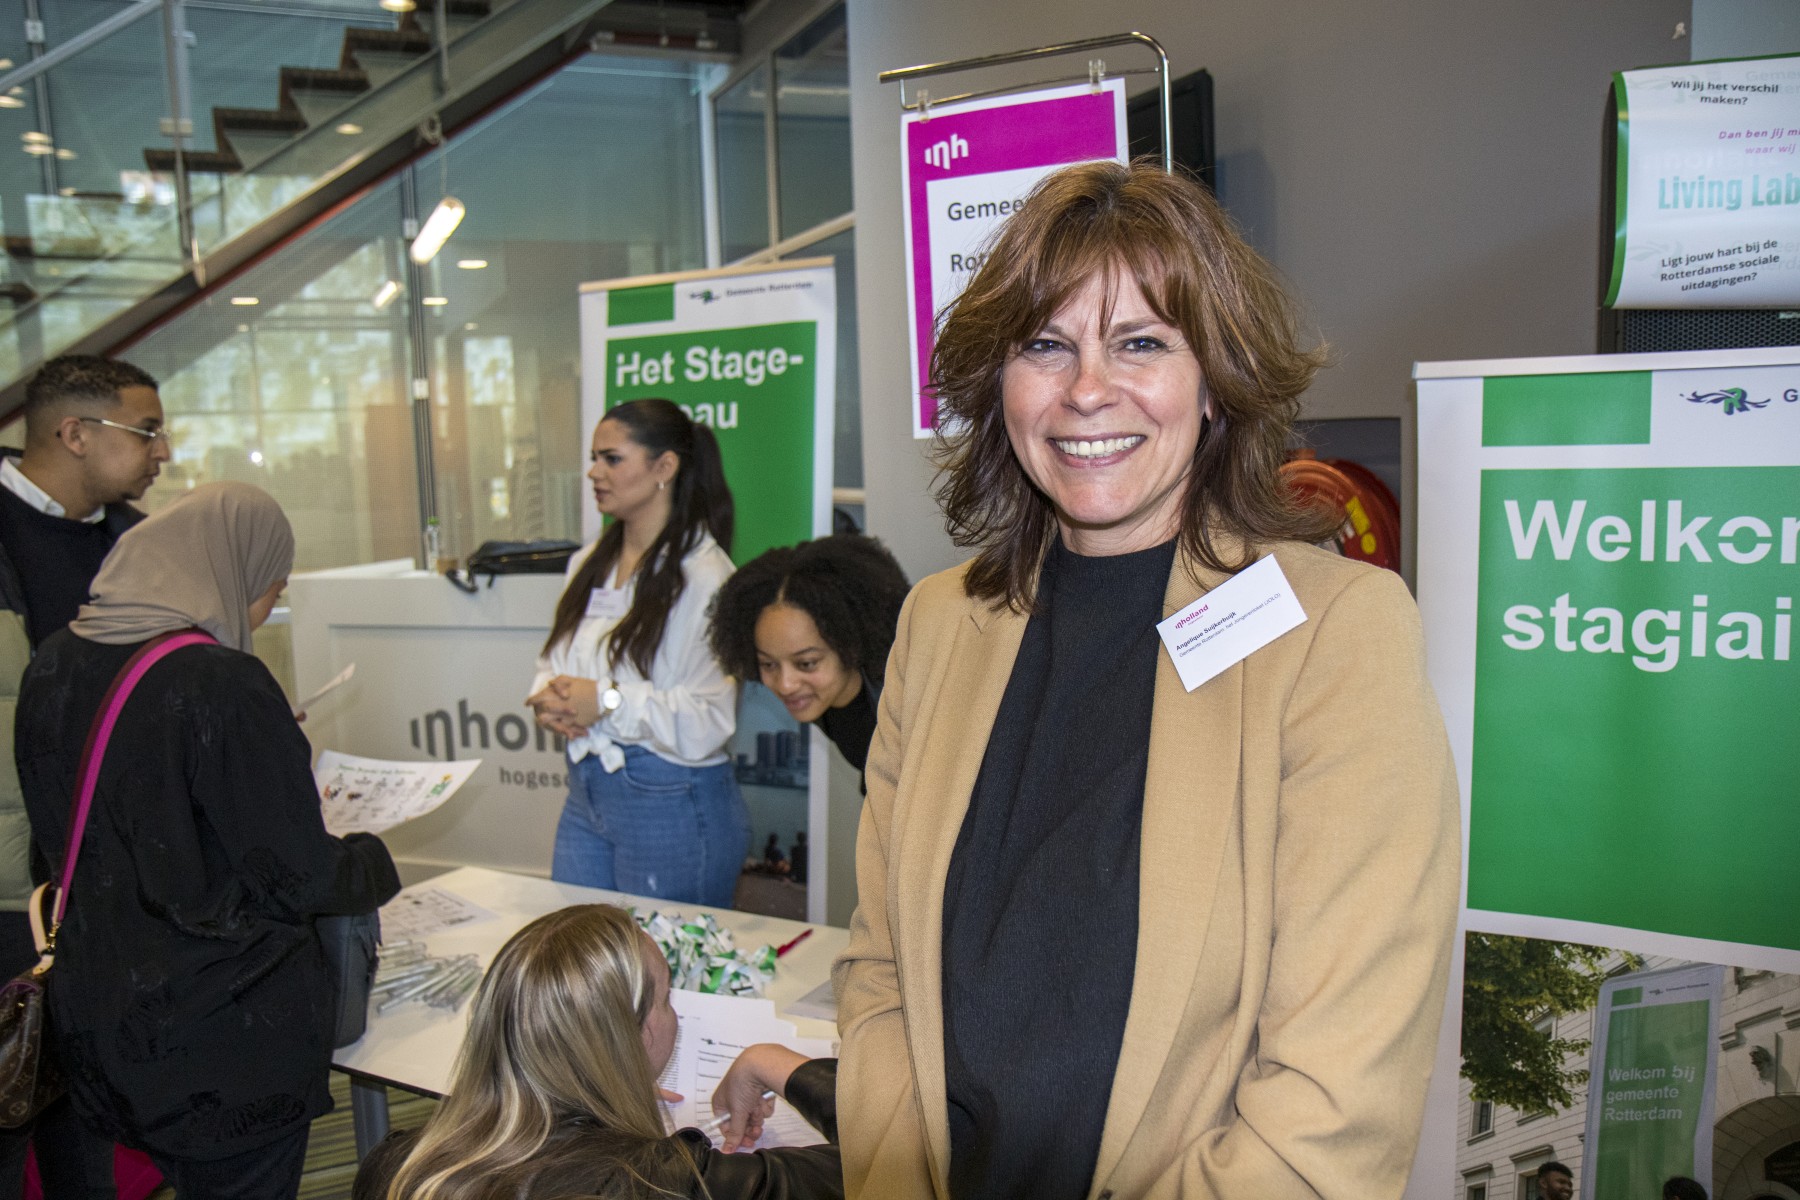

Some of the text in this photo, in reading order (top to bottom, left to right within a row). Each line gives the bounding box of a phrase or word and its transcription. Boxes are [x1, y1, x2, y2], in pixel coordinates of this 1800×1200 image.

[1671, 80, 1690, 89] Wil
[1692, 81, 1704, 92] jij
[1707, 81, 1728, 91] het
[1731, 84, 1779, 94] verschil
[1700, 95, 1748, 105] maken?
[1718, 131, 1742, 139] Dan
[1745, 129, 1768, 138] ben
[1658, 172, 1800, 211] Living Lab
[1661, 257, 1683, 269] Ligt
[1685, 251, 1714, 266] jouw
[1717, 246, 1743, 258] hart
[1745, 242, 1760, 253] bij
[1763, 239, 1778, 250] de
[1660, 262, 1737, 282] Rotterdamse
[1739, 254, 1780, 269] sociale
[1681, 272, 1758, 292] uitdagingen?
[616, 345, 804, 387] Het Stage-
[1503, 499, 1800, 565] Welko
[1176, 632, 1204, 651] Angelique
[499, 766, 569, 790] hoges
[1608, 1065, 1696, 1083] Welkom bij
[1606, 1086, 1679, 1104] gemeente
[1605, 1107, 1682, 1121] Rotterdam
